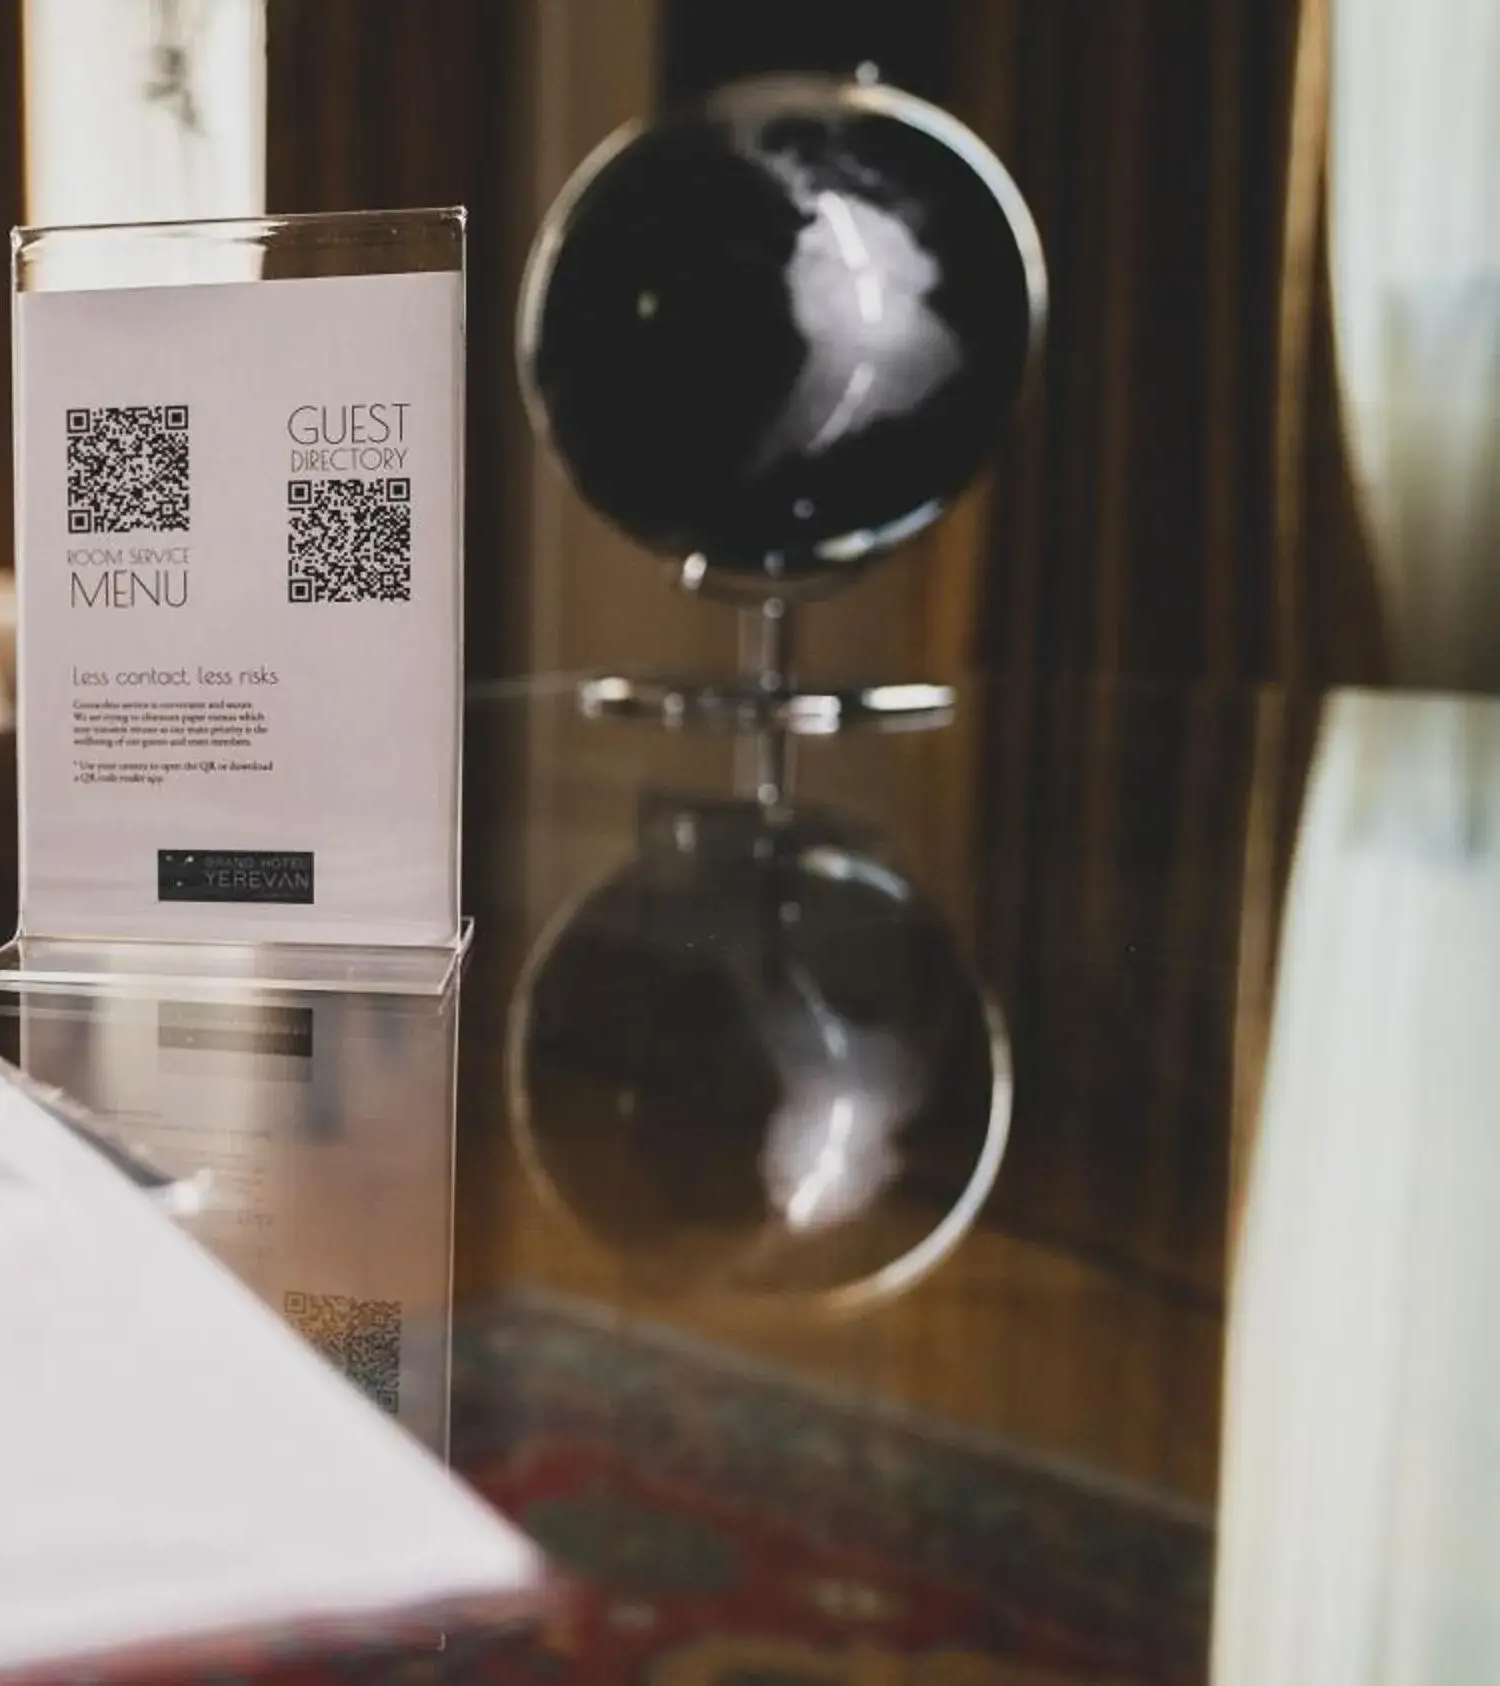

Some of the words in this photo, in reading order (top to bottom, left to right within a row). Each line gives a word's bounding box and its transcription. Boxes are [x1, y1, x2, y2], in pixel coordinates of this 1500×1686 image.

[288, 403, 411, 445] GUEST
[291, 448, 408, 473] DIRECTORY
[67, 549, 123, 567] ROOM
[129, 547, 189, 565] SERVICE
[71, 569, 188, 608] MENU
[73, 665, 109, 686] Less
[198, 666, 233, 686] less
[239, 665, 279, 686] risks
[208, 699, 225, 709] and
[238, 711, 265, 721] which
[254, 724, 269, 734] the
[169, 736, 187, 746] and
[184, 761, 197, 770] the
[199, 761, 216, 773] QR
[229, 760, 274, 771] download
[79, 773, 96, 784] QR
[205, 870, 310, 891] YEREVAN
